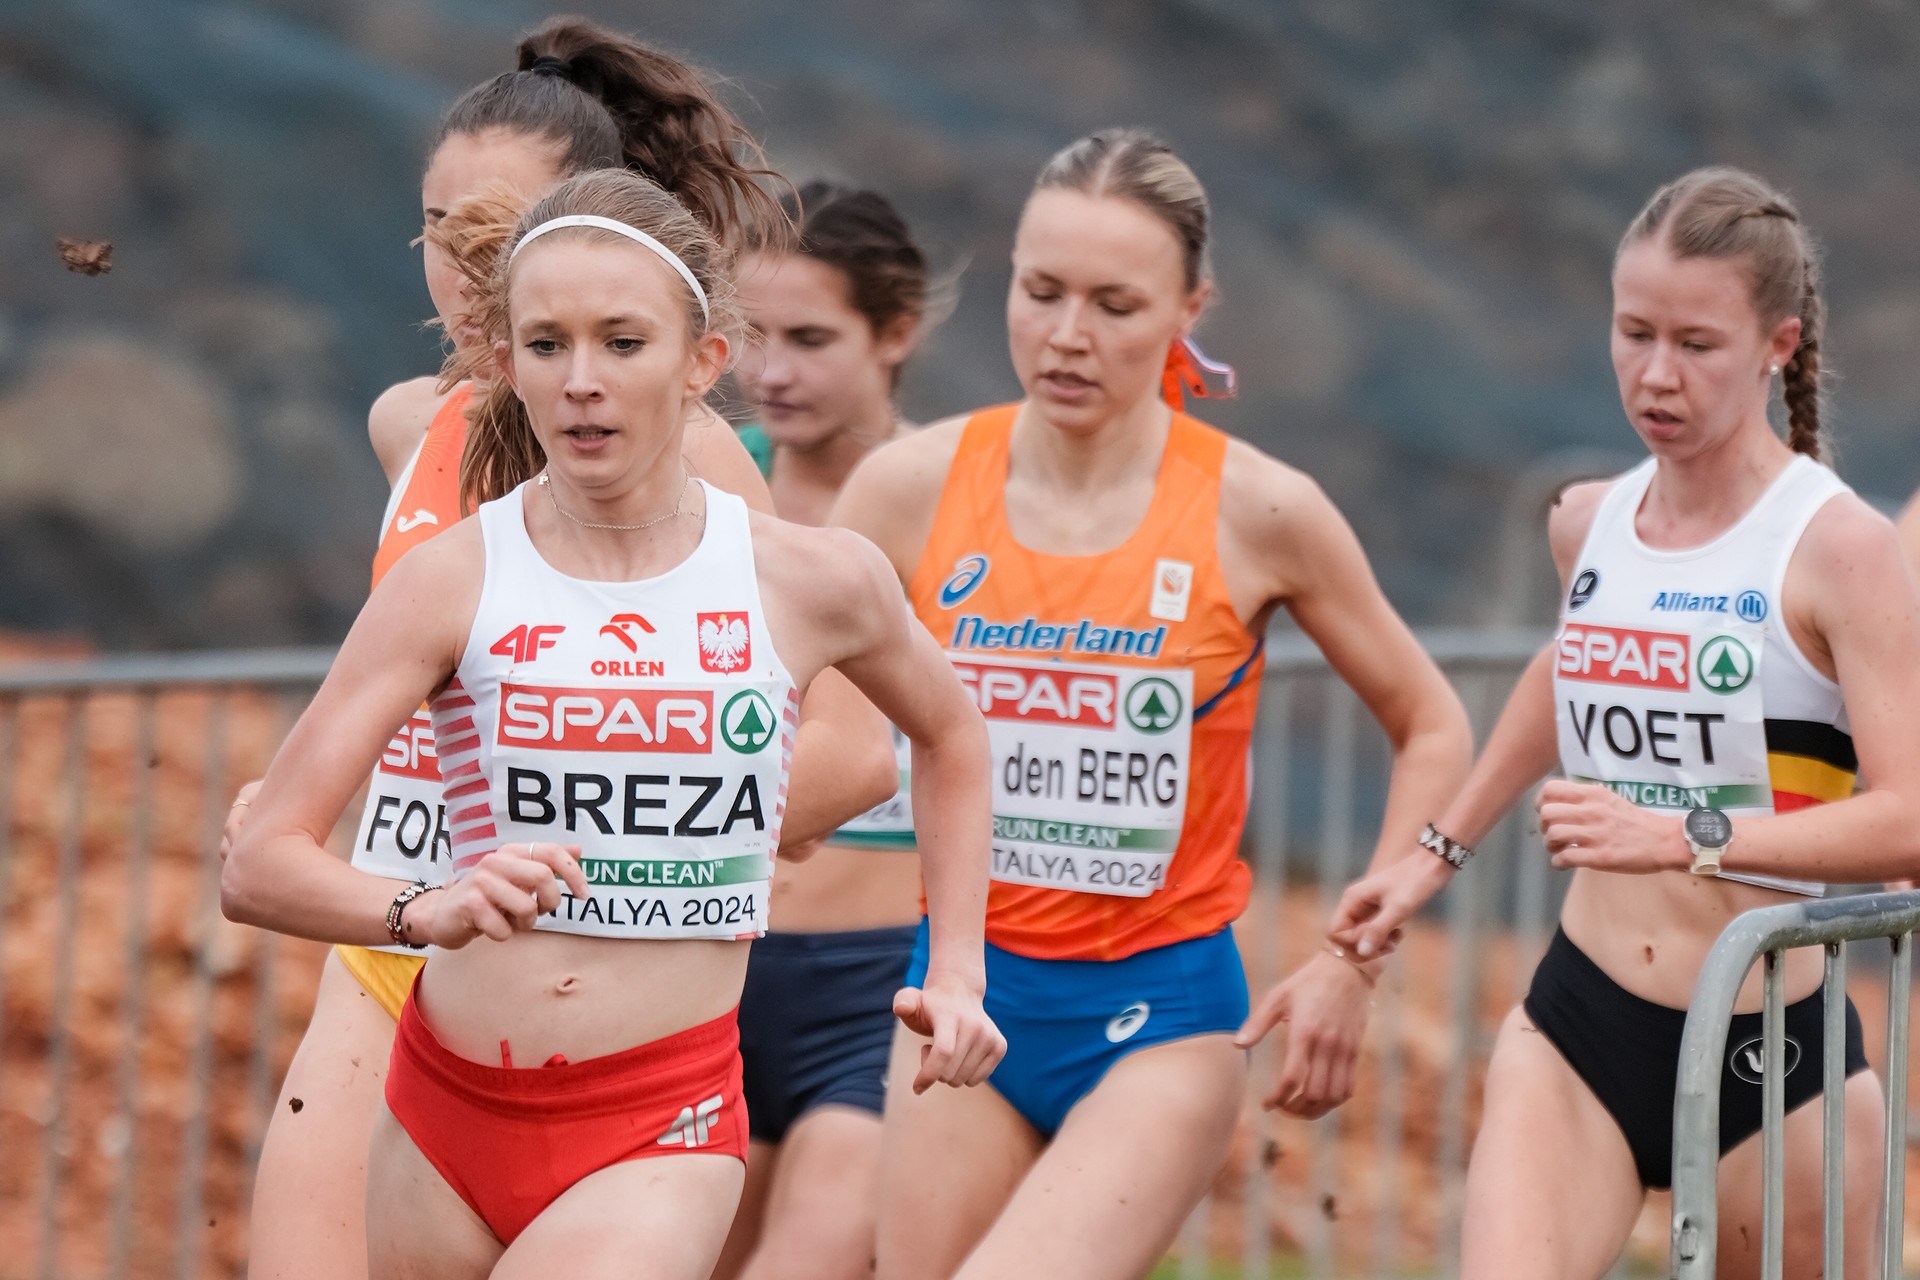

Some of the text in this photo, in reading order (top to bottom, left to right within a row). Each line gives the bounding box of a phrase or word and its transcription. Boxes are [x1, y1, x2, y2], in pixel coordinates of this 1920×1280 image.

[1650, 592, 1728, 613] Allianz
[489, 624, 567, 664] 4F
[1558, 631, 1686, 685] SPAR
[591, 661, 665, 677] ORLEN
[504, 692, 707, 745] SPAR
[1568, 701, 1725, 767] VOET
[382, 724, 442, 773] SP
[1004, 742, 1178, 809] den BERG
[507, 766, 765, 838] BREZA
[581, 862, 619, 883] UN
[993, 849, 1162, 887] TALYA 2024
[549, 892, 756, 927] TALYA 2024
[657, 1094, 723, 1148] 4F
